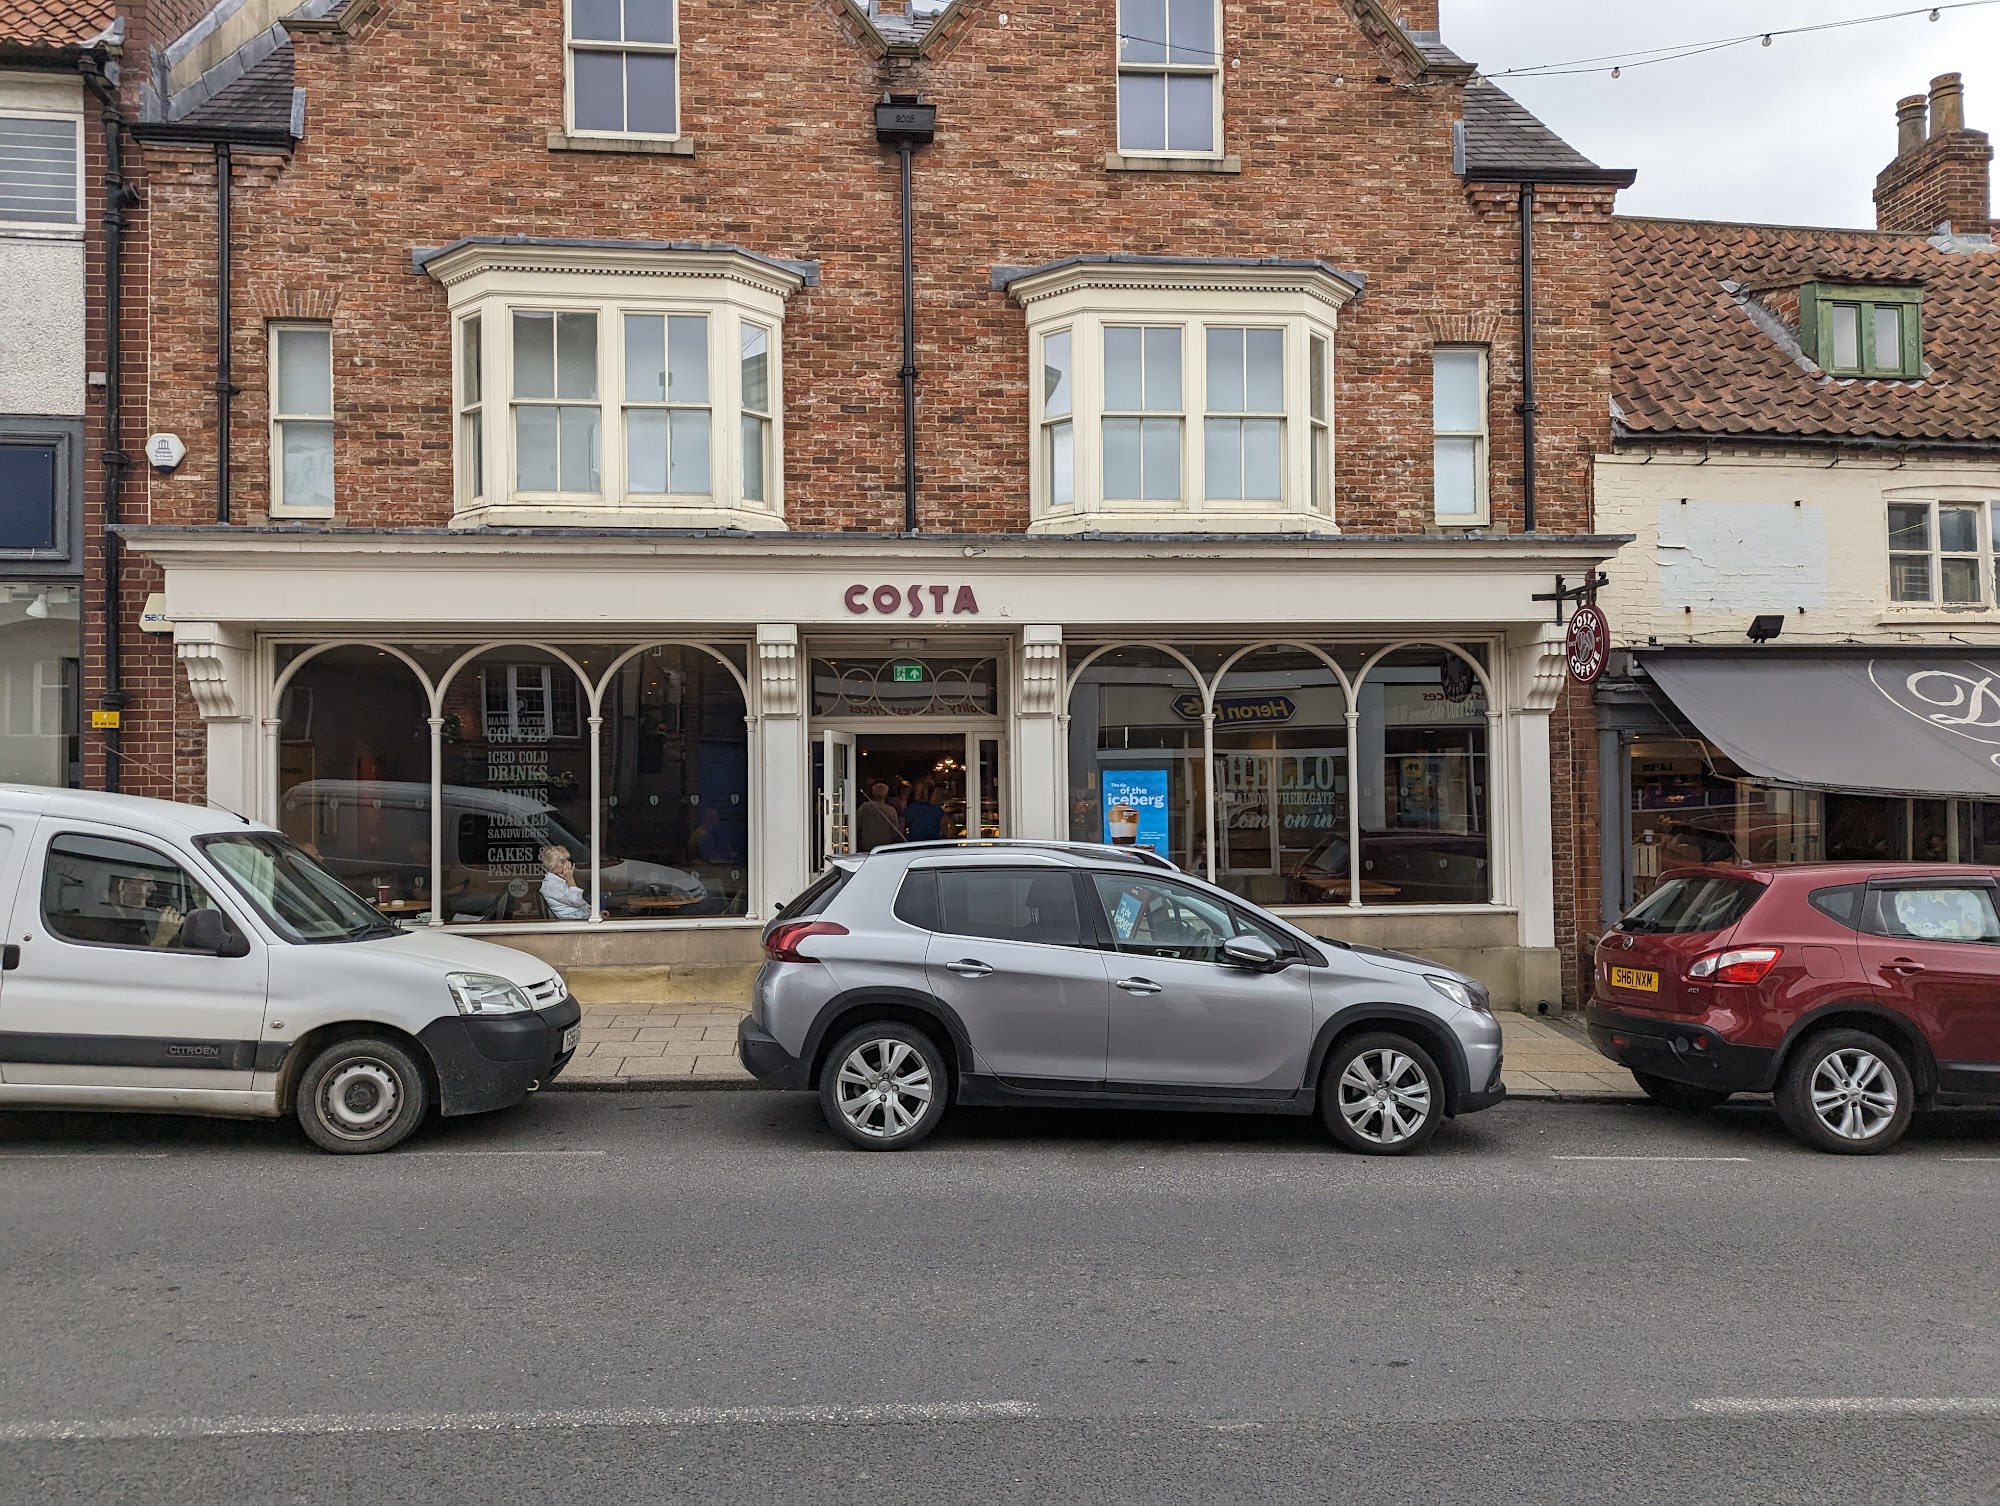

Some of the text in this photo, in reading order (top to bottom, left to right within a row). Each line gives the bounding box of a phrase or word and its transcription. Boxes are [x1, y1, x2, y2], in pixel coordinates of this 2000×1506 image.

[845, 584, 979, 617] COSTA
[1572, 612, 1597, 634] COSTA
[1571, 650, 1600, 677] COFFEE
[488, 716, 547, 726] HANAFTE
[487, 726, 548, 743] COFFEE
[487, 750, 548, 764] ICED COLD
[487, 765, 548, 781] DRINKS
[1226, 755, 1335, 790] HELLO
[1120, 786, 1147, 795] of the
[1107, 793, 1165, 809] iceberg
[488, 813, 549, 827] TOASTED
[1284, 813, 1310, 828] on
[1313, 807, 1337, 828] in
[487, 828, 549, 839] SANDWICHES
[488, 846, 533, 862] CAKES
[488, 863, 548, 877] PASTRIES
[1617, 969, 1634, 985] SH61
[1636, 973, 1653, 988] NXM
[169, 1045, 219, 1055] CITROËN
